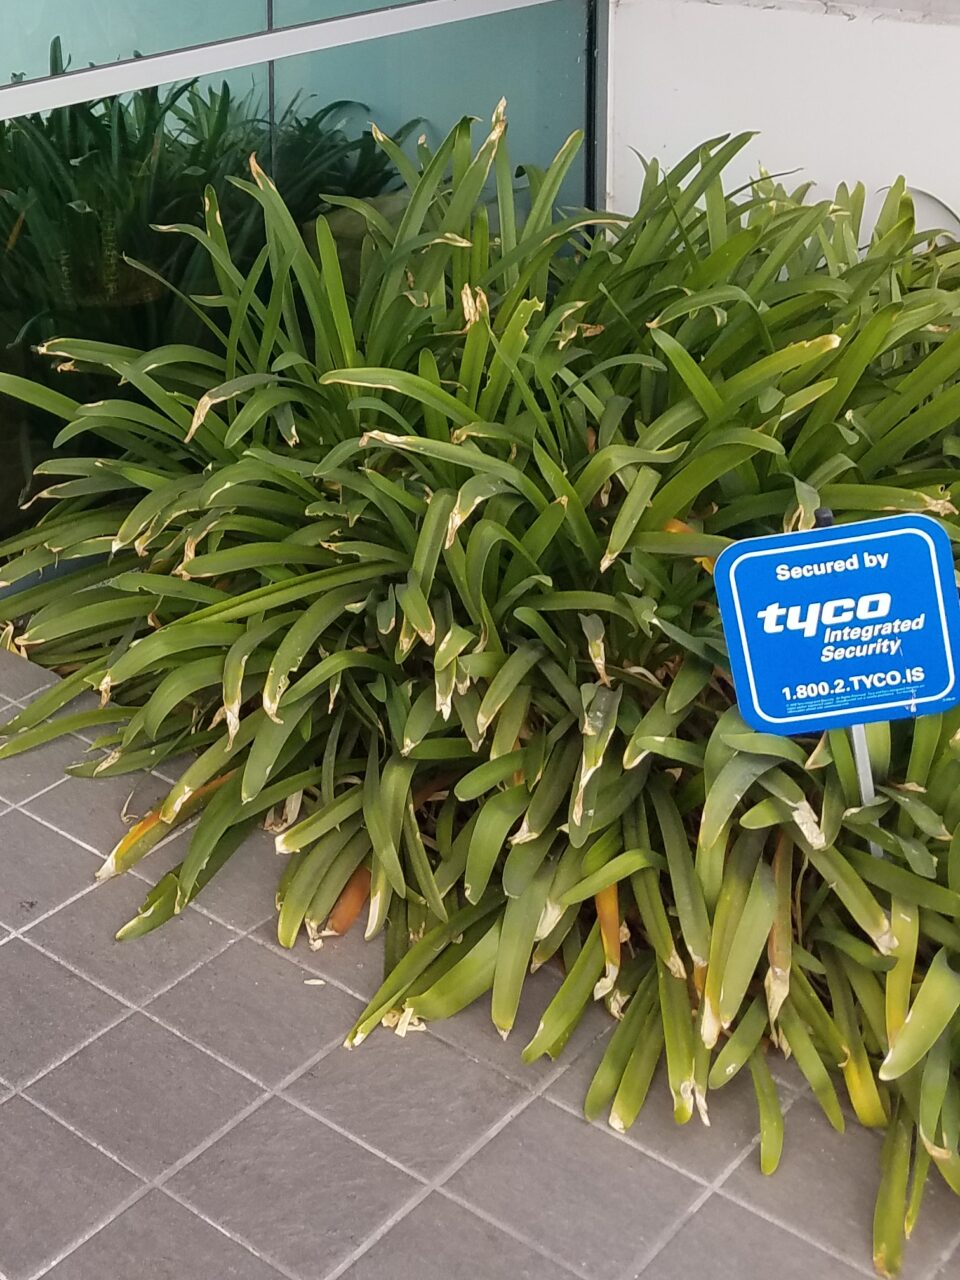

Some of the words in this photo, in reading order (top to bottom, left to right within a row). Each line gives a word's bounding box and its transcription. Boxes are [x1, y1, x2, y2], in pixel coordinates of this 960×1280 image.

[776, 554, 859, 581] Secured
[863, 552, 889, 570] by
[757, 592, 892, 638] tyco
[824, 614, 925, 644] Integrated
[820, 638, 901, 663] Security
[782, 666, 925, 701] 1.800.2.TYCO.IS
